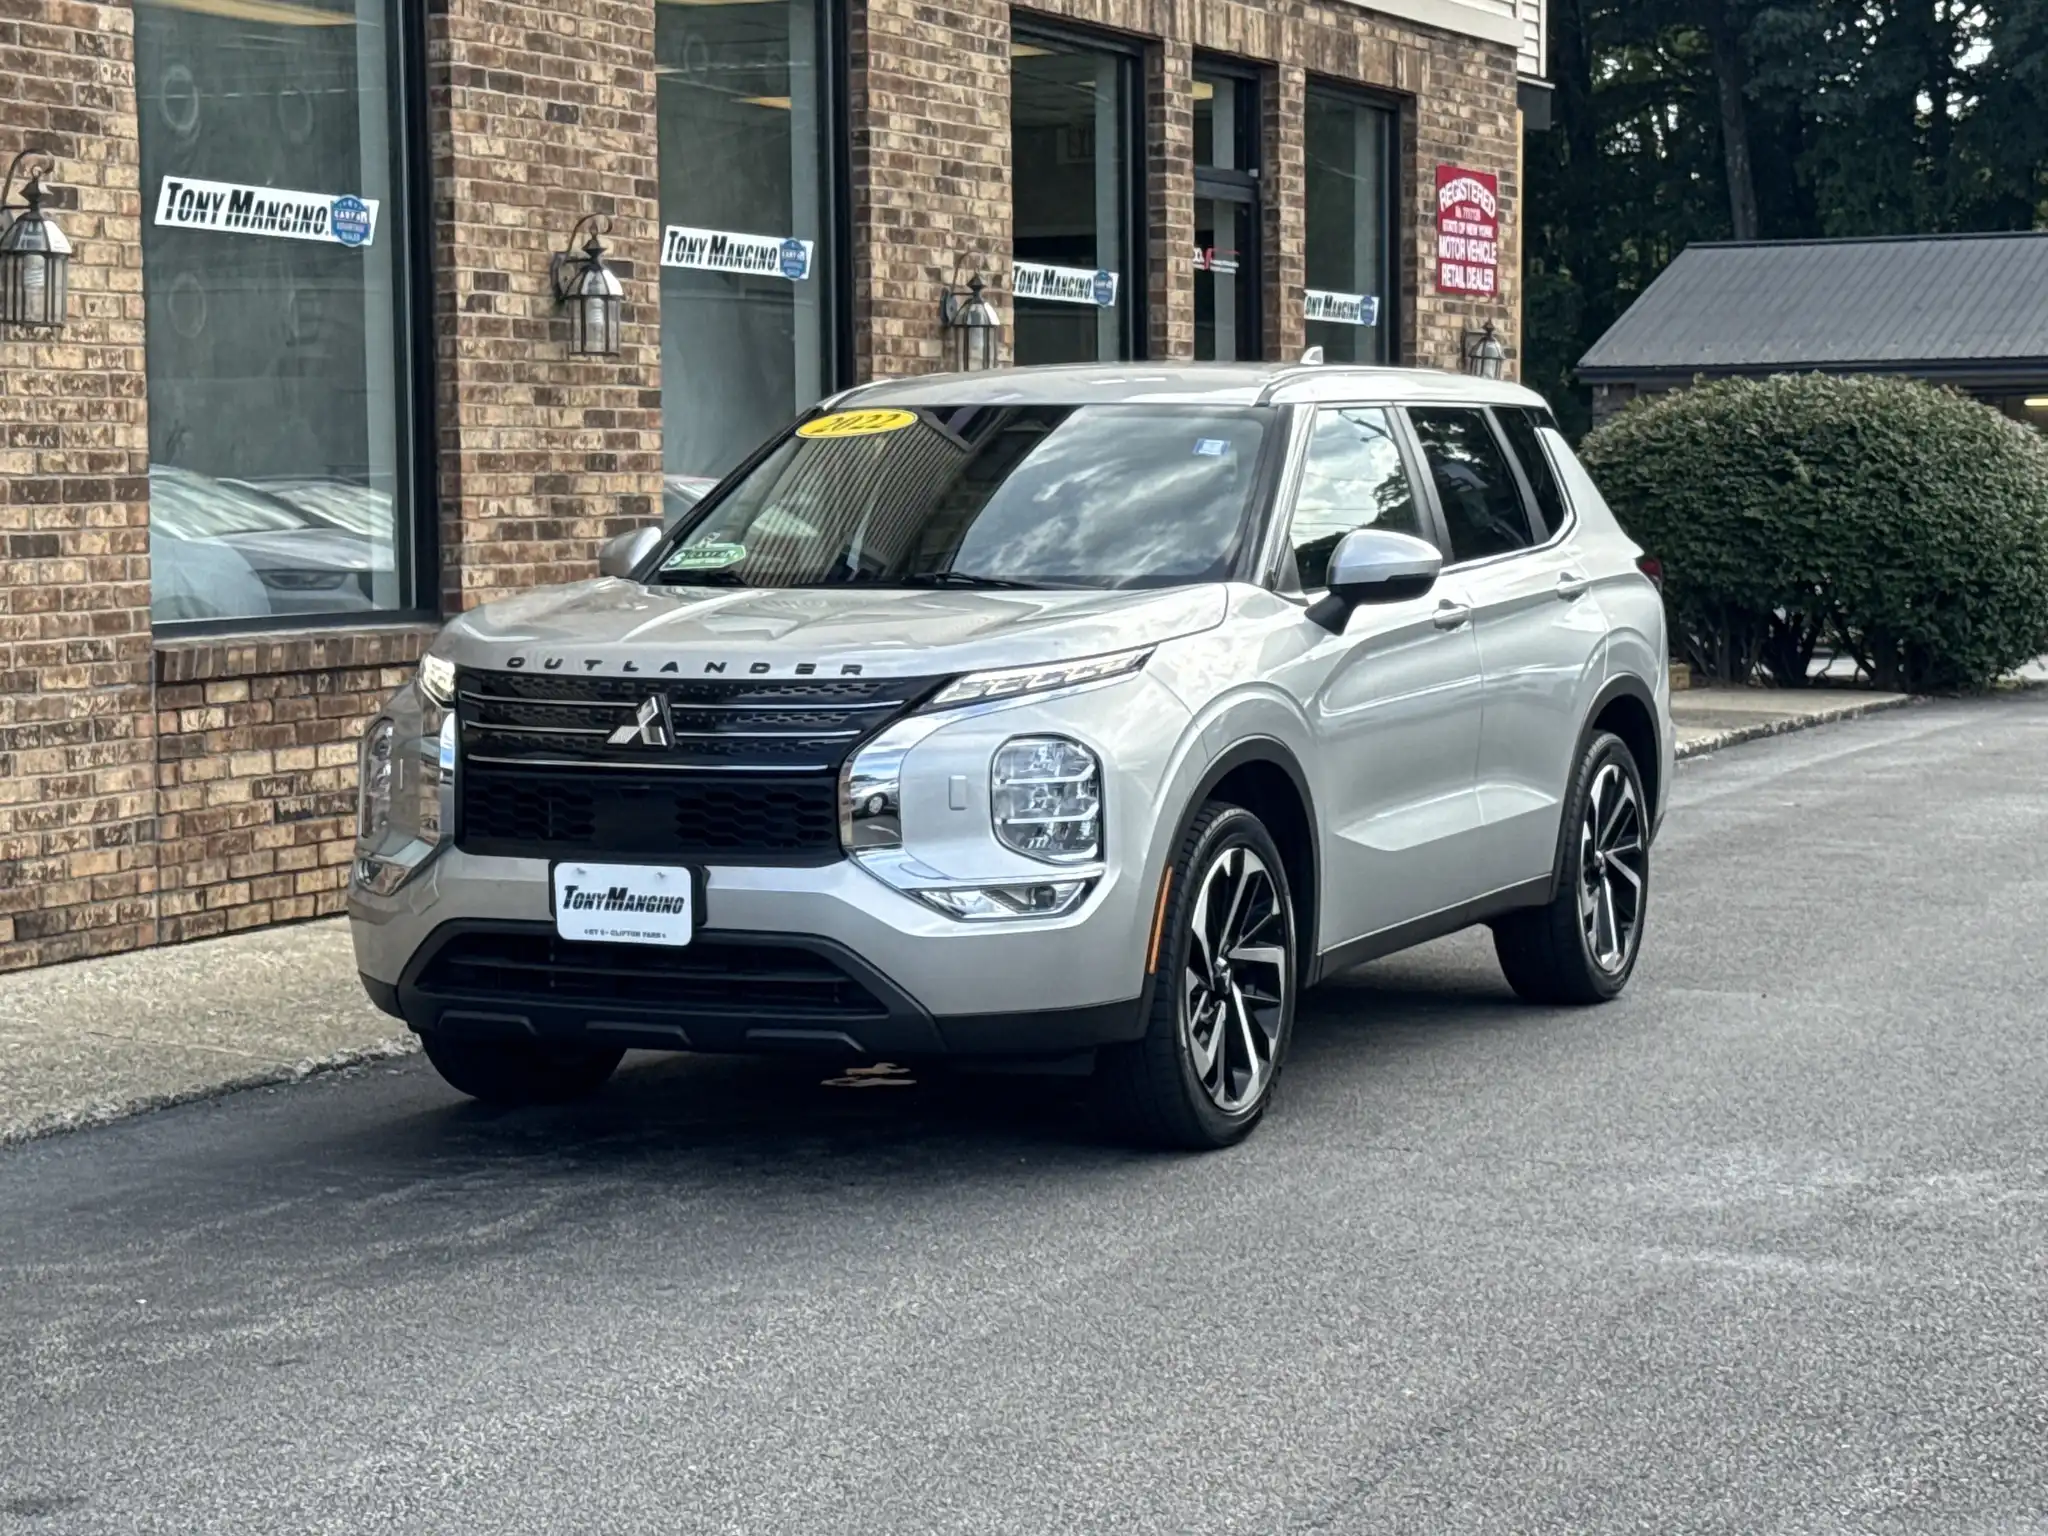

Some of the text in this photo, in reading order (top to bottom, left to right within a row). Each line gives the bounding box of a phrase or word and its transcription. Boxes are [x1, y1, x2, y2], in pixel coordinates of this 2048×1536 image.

[165, 182, 226, 225] TONY
[1439, 177, 1496, 219] REGISTERED
[666, 231, 708, 265] TONY
[1439, 235, 1497, 265] MOTOR VEHICLE
[1012, 266, 1042, 295] TONY
[1441, 262, 1494, 291] RETAIL DEALER
[1305, 294, 1323, 317] ONY
[506, 657, 866, 675] OUTLANDER
